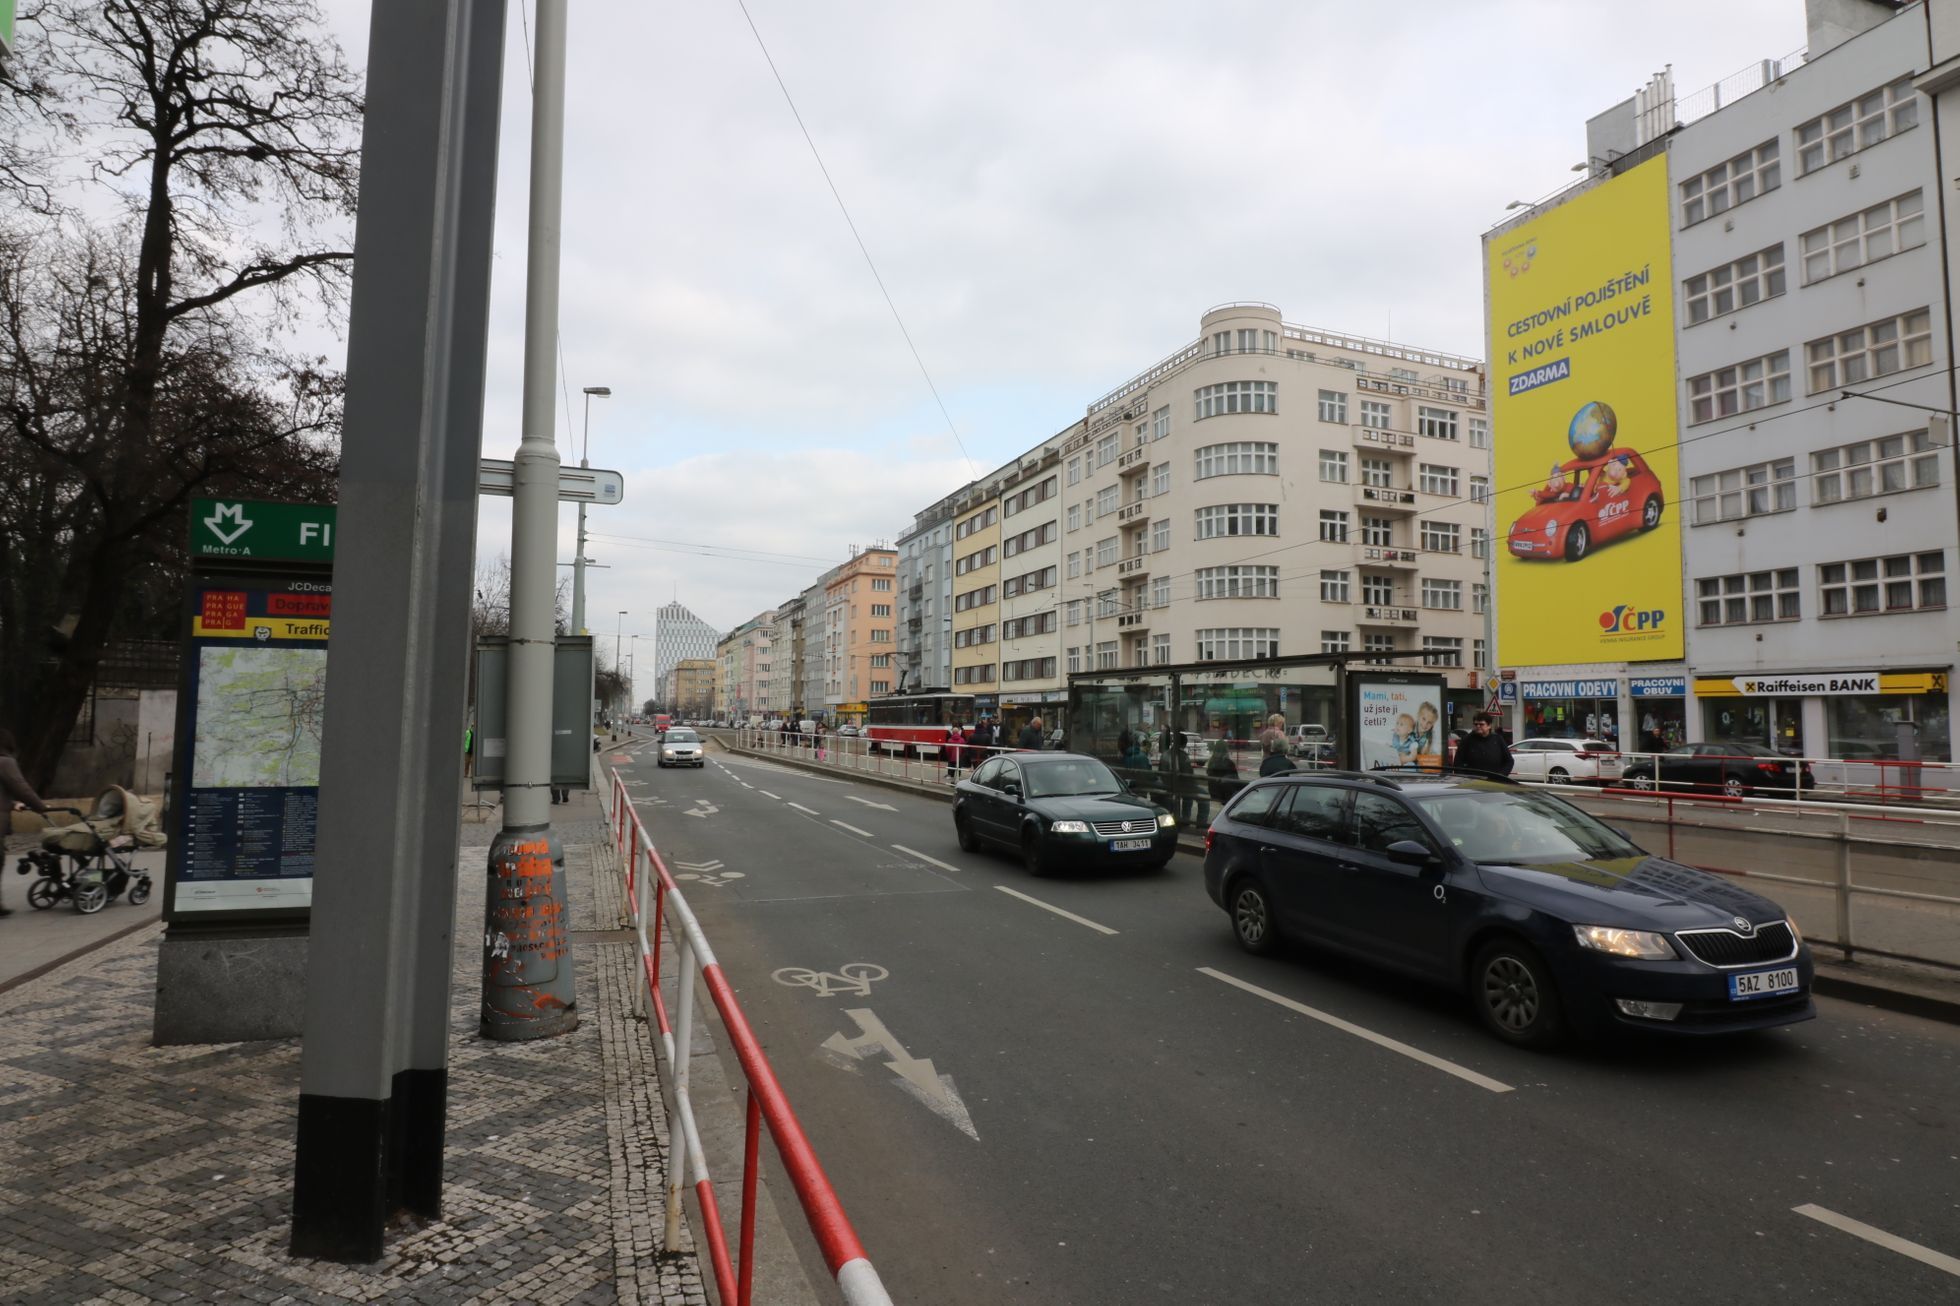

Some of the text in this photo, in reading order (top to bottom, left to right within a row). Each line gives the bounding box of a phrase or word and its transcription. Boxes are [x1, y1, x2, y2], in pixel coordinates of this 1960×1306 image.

[1507, 264, 1650, 338] CESTOVNÍ POJIŠTĚNÍ
[1508, 295, 1651, 365] K NOVÉ SMLOUVĚ
[1510, 362, 1569, 393] ZDARMA
[1622, 606, 1665, 631] ČPP
[1643, 686, 1673, 695] OBUV
[1757, 678, 1876, 693] Raiffeisen BANK
[1363, 690, 1408, 702] Mami, tati,
[1363, 704, 1374, 713] už
[1375, 705, 1391, 715] jste
[1363, 716, 1387, 726] četli?
[1739, 976, 1760, 992] 5AZ
[1768, 971, 1793, 988] 8100
